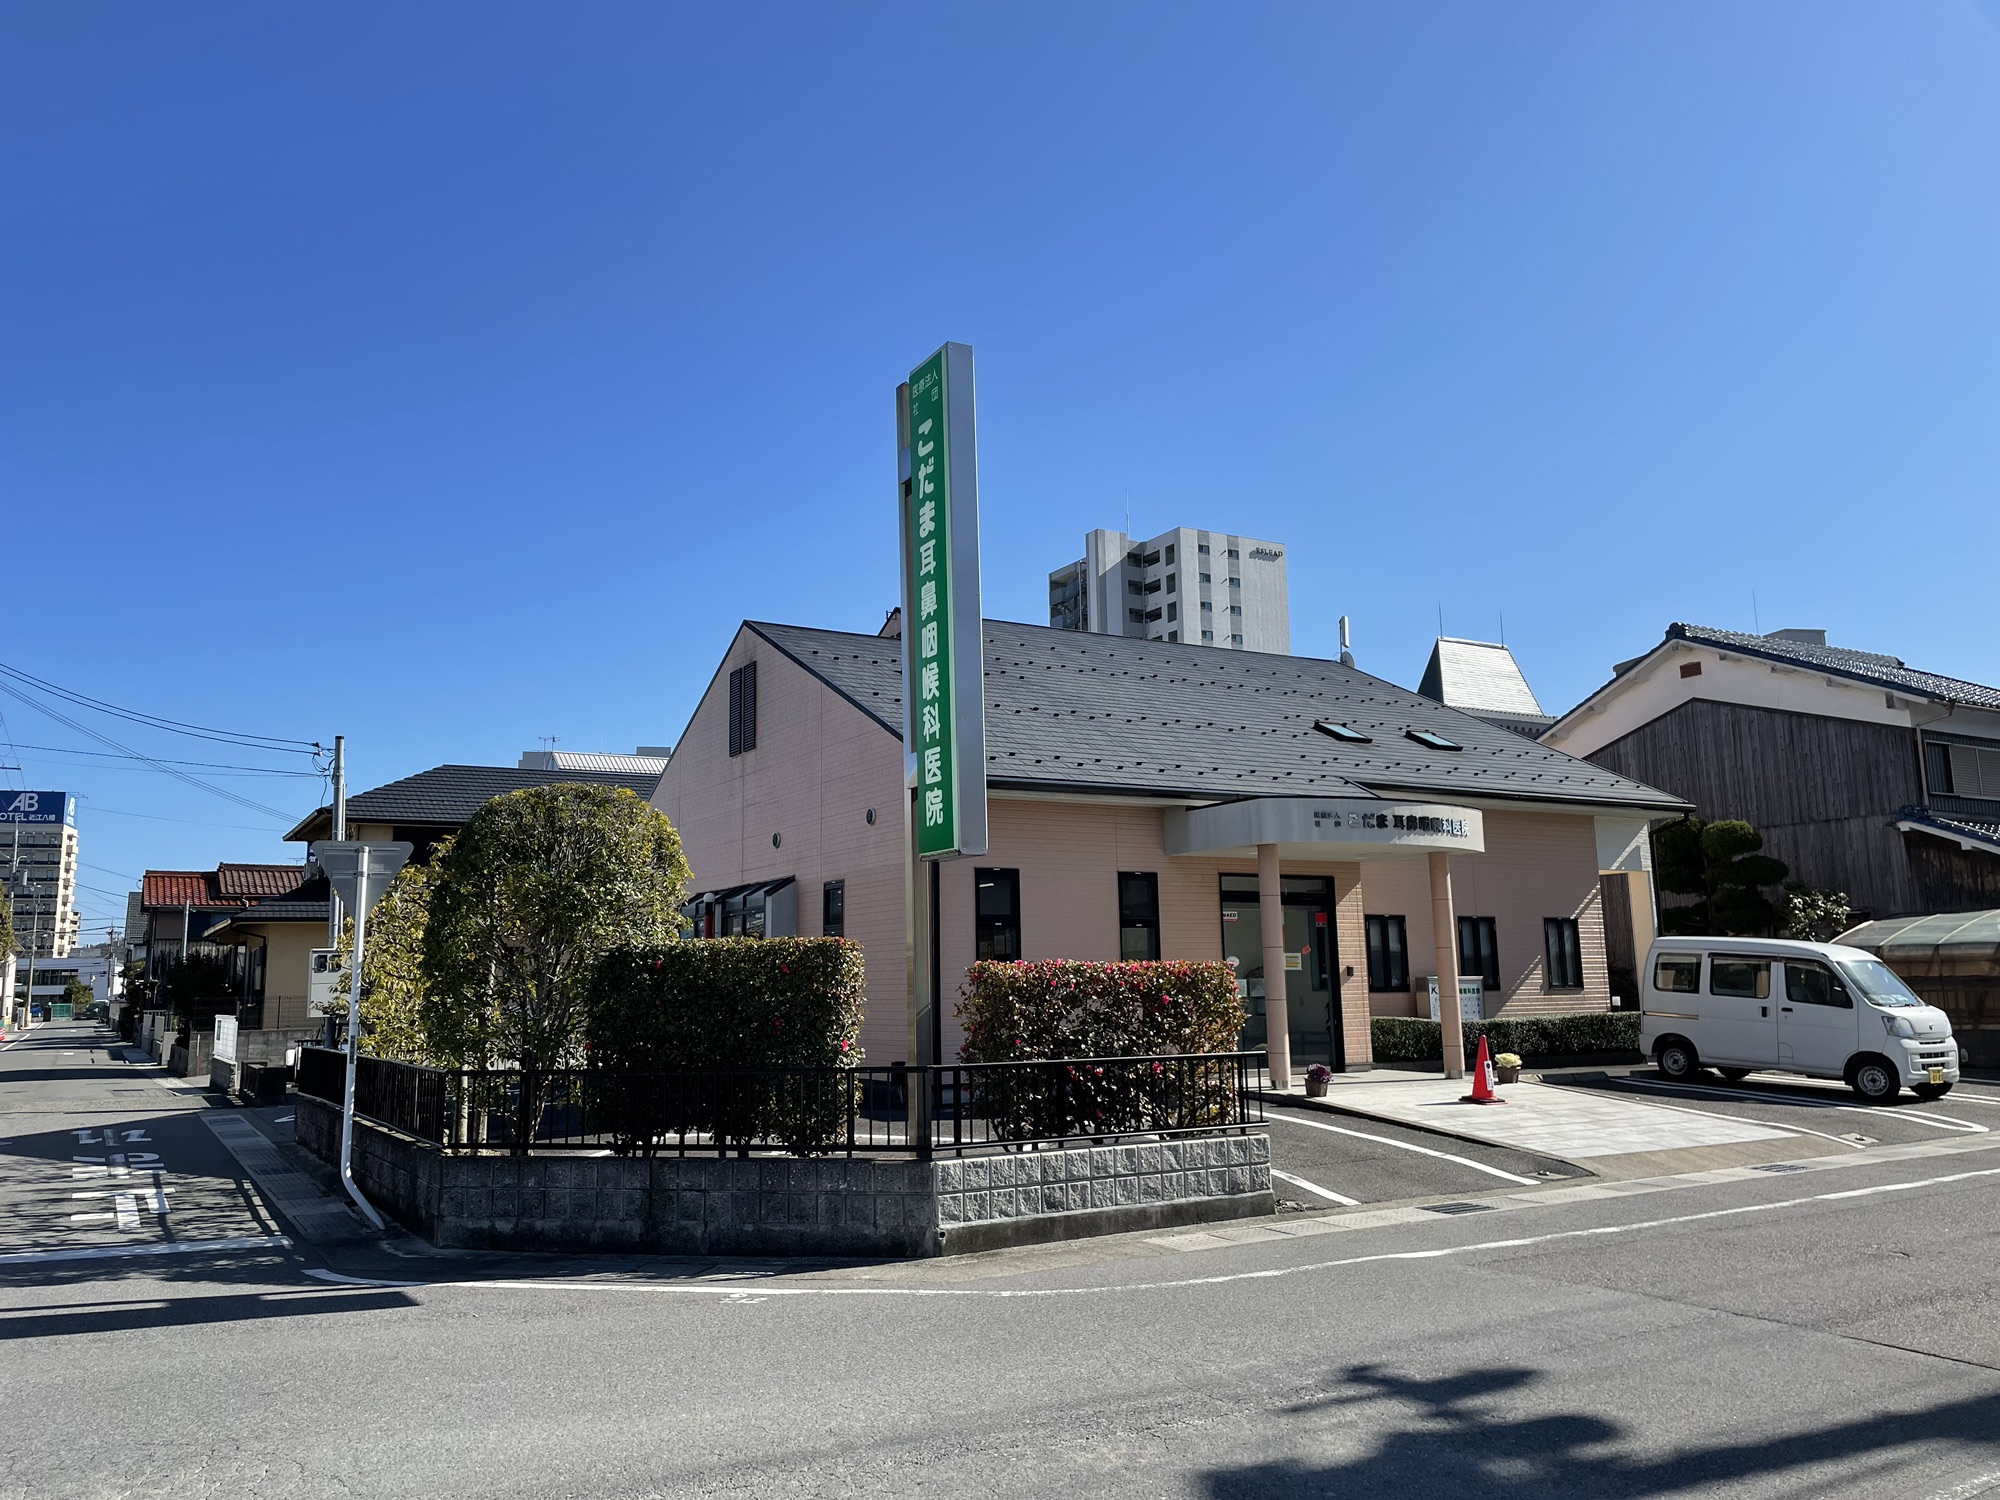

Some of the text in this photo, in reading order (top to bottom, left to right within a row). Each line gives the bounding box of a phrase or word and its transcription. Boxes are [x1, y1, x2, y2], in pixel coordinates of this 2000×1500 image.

[1255, 547, 1284, 558] ESLEAD
[917, 417, 944, 828] こだま耳鼻咽喉科医院
[7, 792, 39, 812] AB
